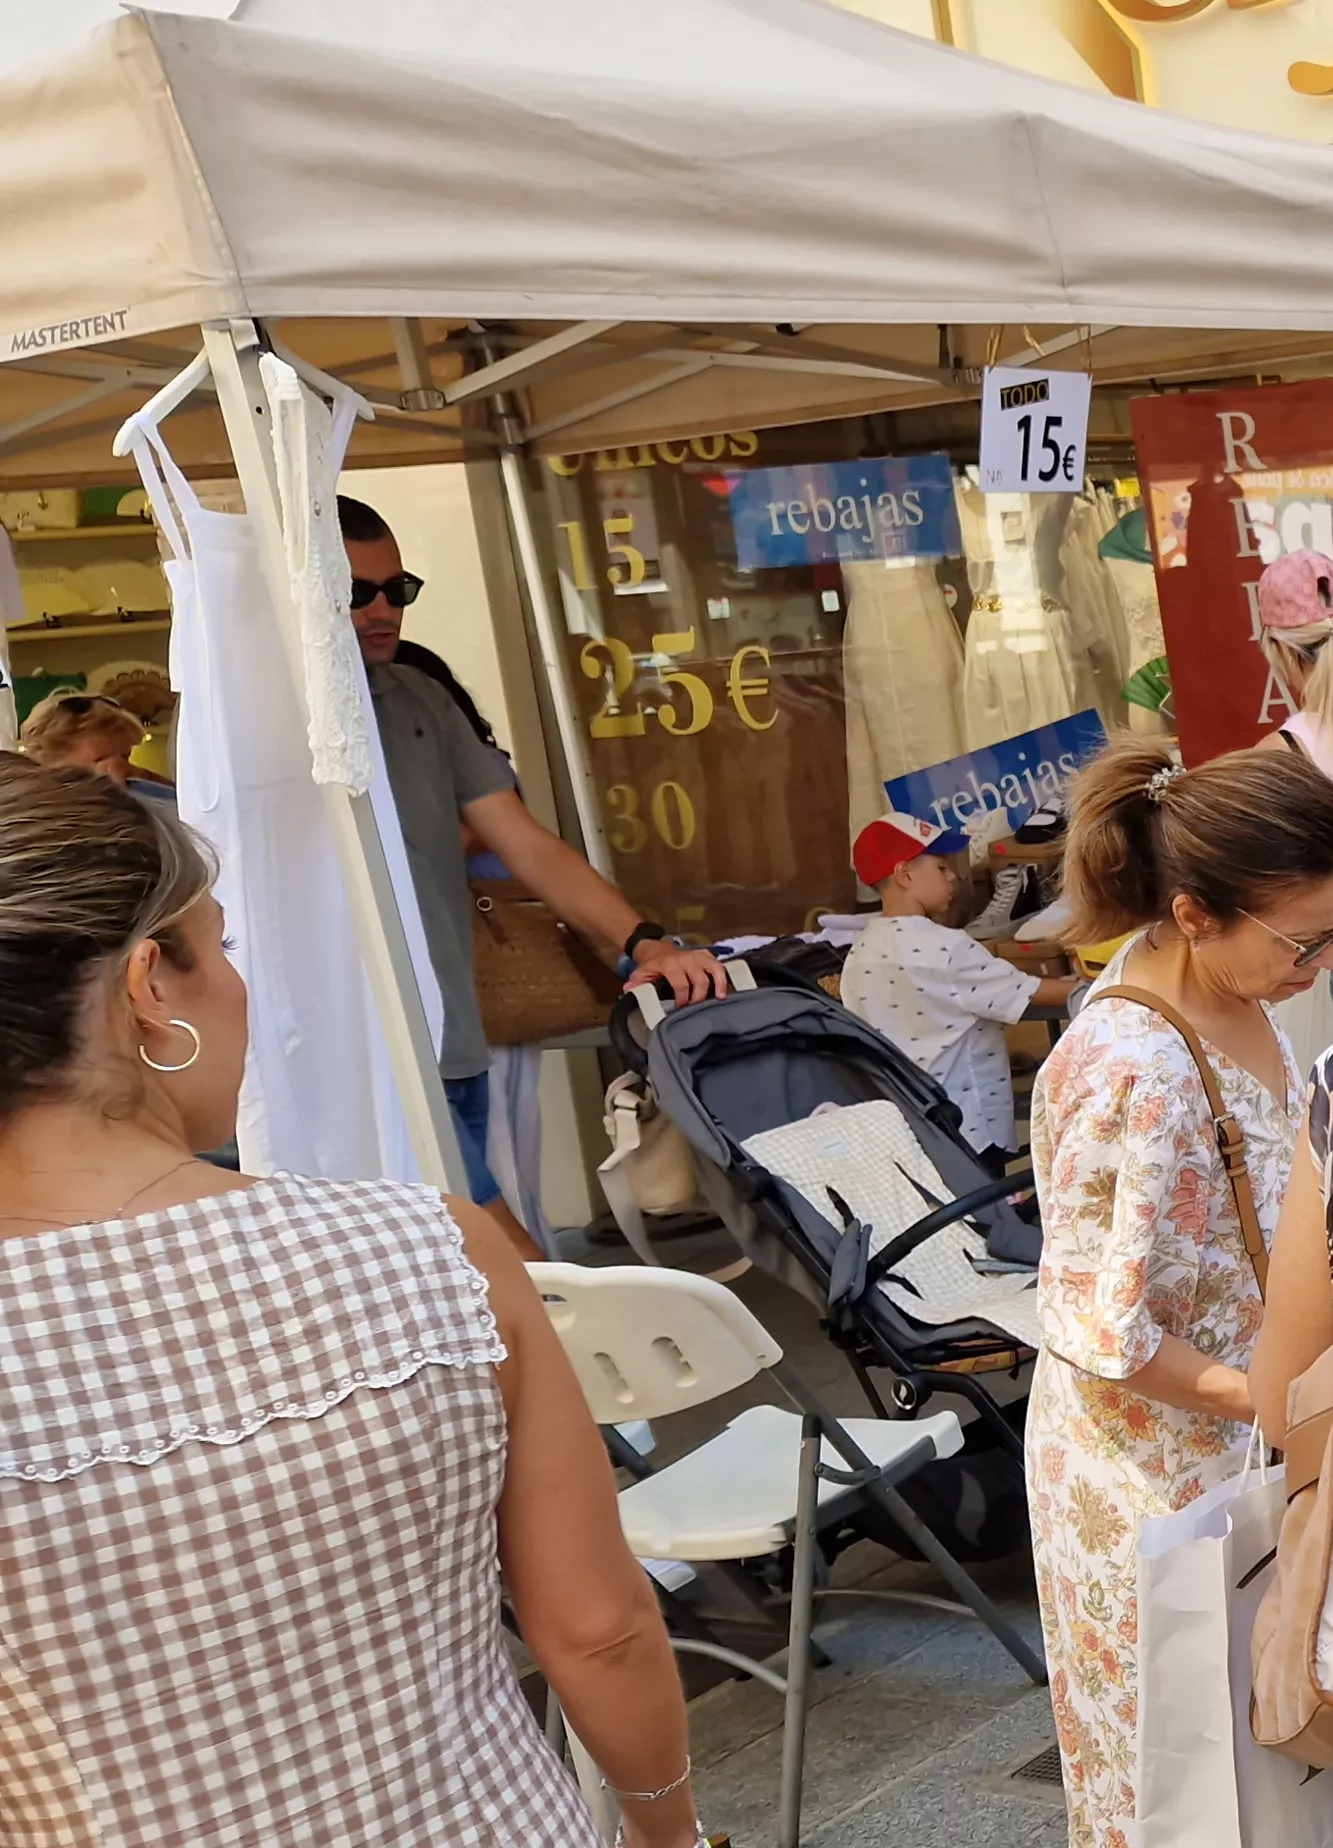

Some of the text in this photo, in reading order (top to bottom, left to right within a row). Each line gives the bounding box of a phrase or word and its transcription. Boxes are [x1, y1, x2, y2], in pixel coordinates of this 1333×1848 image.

[11, 309, 127, 352] MASTERTENT
[1001, 381, 1048, 409] TODO
[1017, 414, 1077, 482] 15€
[766, 478, 924, 543] rebajas
[557, 514, 645, 590] 15
[606, 782, 694, 853] 30
[929, 751, 1081, 832] rebajas
